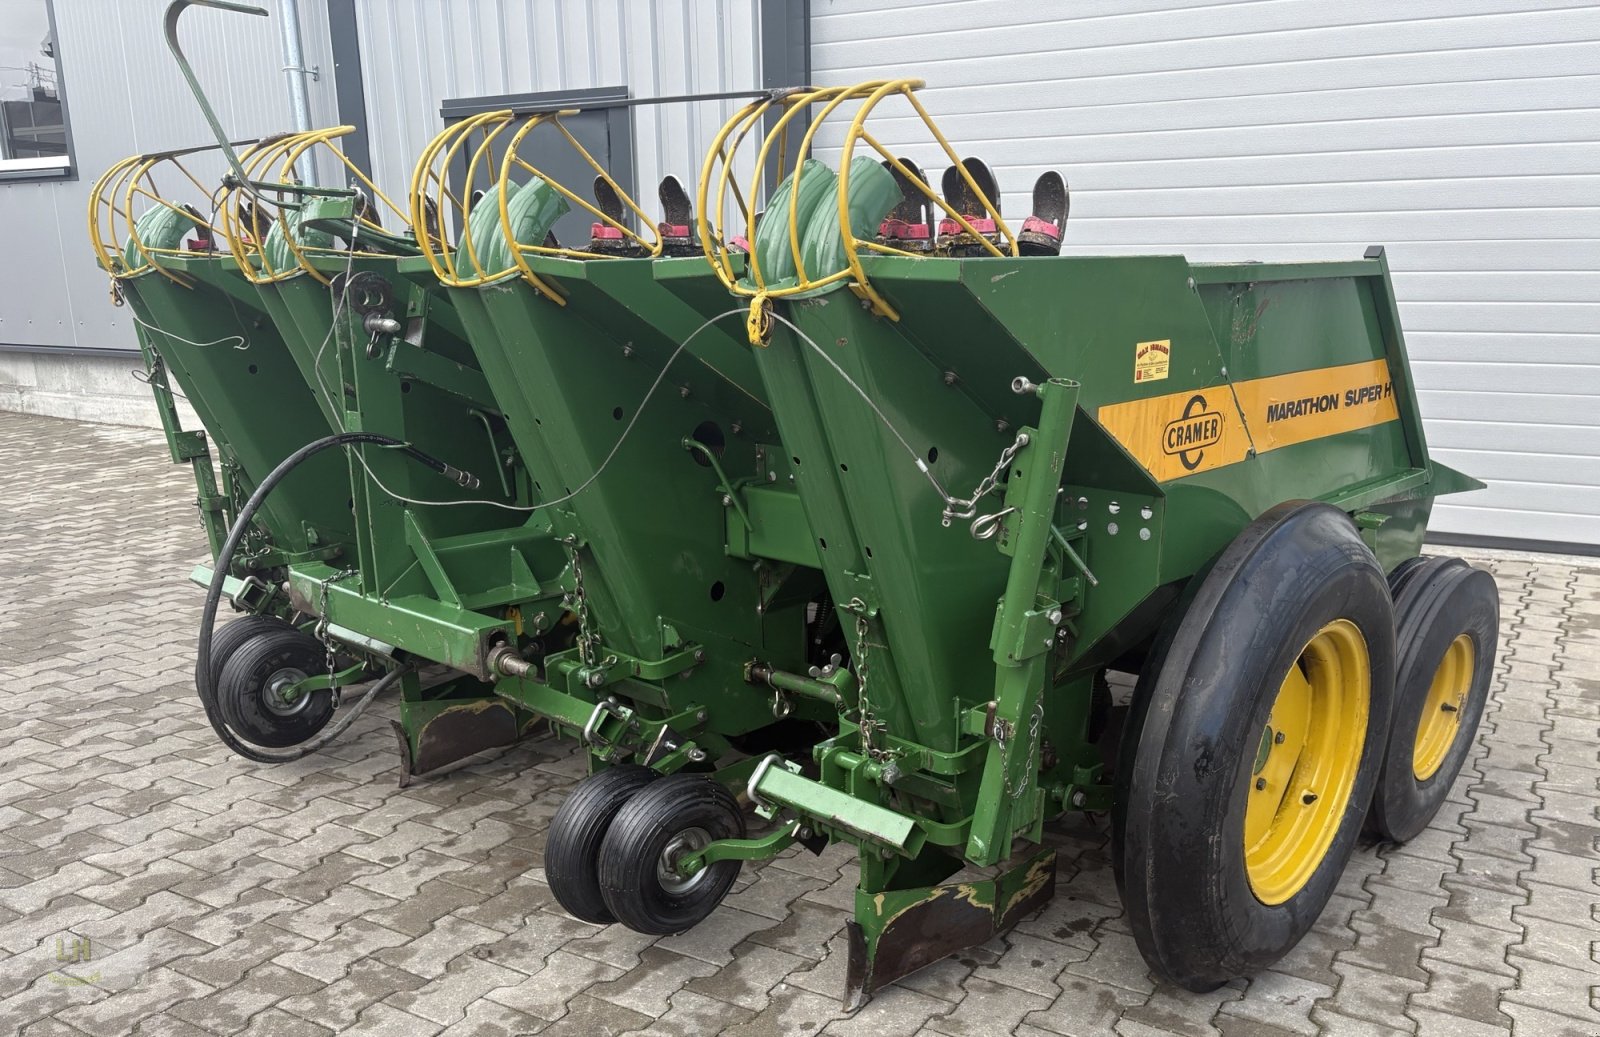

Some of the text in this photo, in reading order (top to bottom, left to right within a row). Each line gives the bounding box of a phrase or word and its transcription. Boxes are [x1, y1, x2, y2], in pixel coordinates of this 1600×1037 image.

[1267, 382, 1393, 423] MARATHON SUPER H
[1167, 419, 1218, 449] CRAMER
